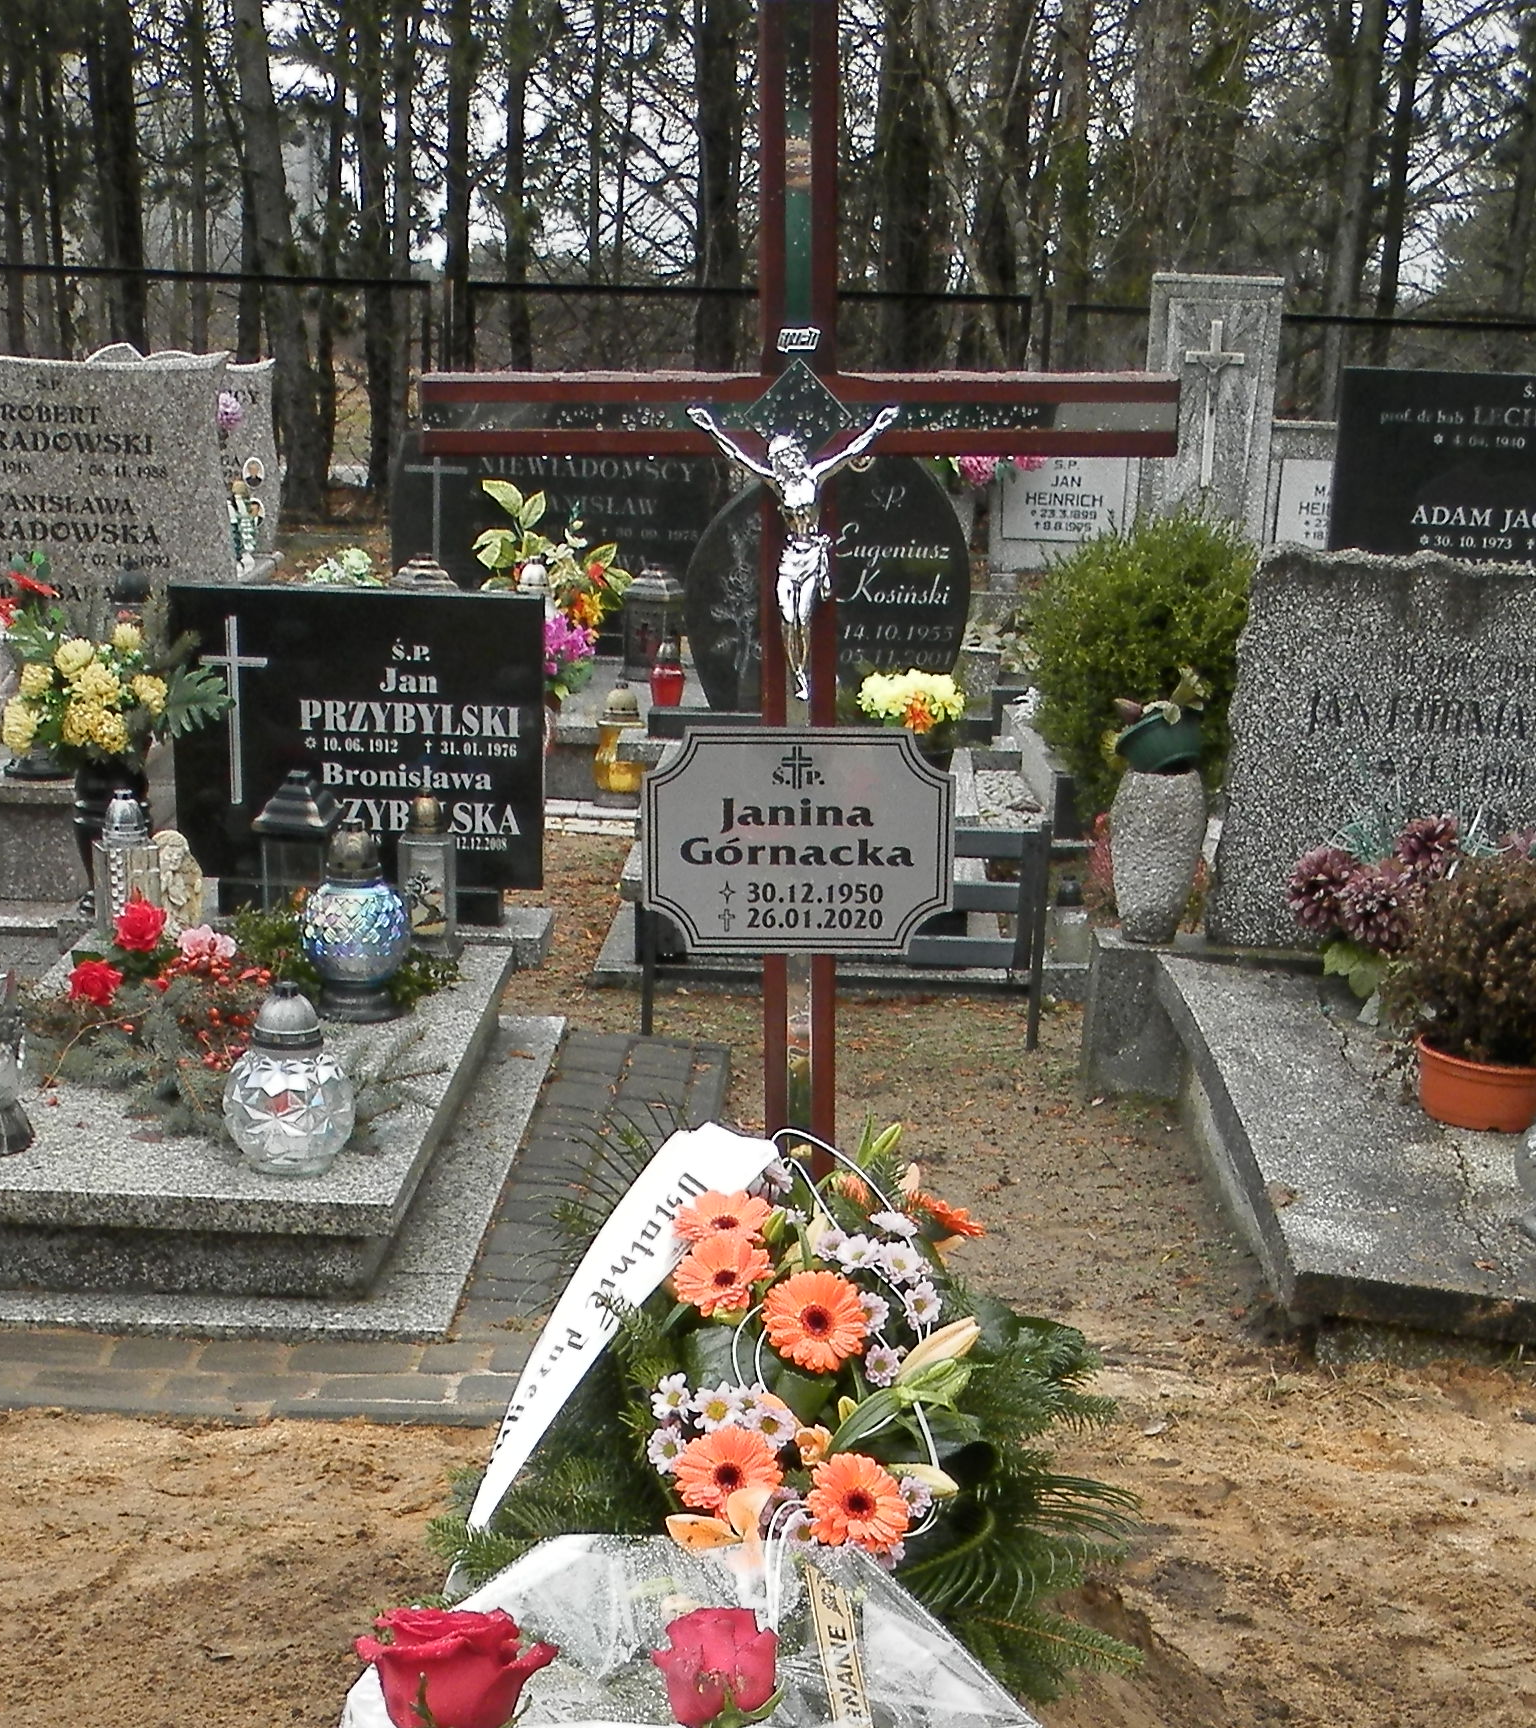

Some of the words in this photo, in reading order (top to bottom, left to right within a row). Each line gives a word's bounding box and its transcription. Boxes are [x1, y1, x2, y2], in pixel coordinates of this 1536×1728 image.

[0, 403, 101, 425] ROBERT
[1051, 475, 1081, 487] JAN
[1025, 492, 1103, 507] HEINRICH
[1411, 504, 1493, 528] ADAM
[836, 522, 950, 568] Eugeniusz
[836, 568, 950, 605] Kosiński
[379, 667, 438, 693] Jan
[300, 699, 520, 738] PRZYBYLSKI
[322, 762, 492, 791] Bronisława
[719, 798, 874, 833] Janina
[680, 837, 914, 867] Górnacka
[746, 882, 884, 904] 30.12.1950
[746, 908, 884, 930] 26.01.2020
